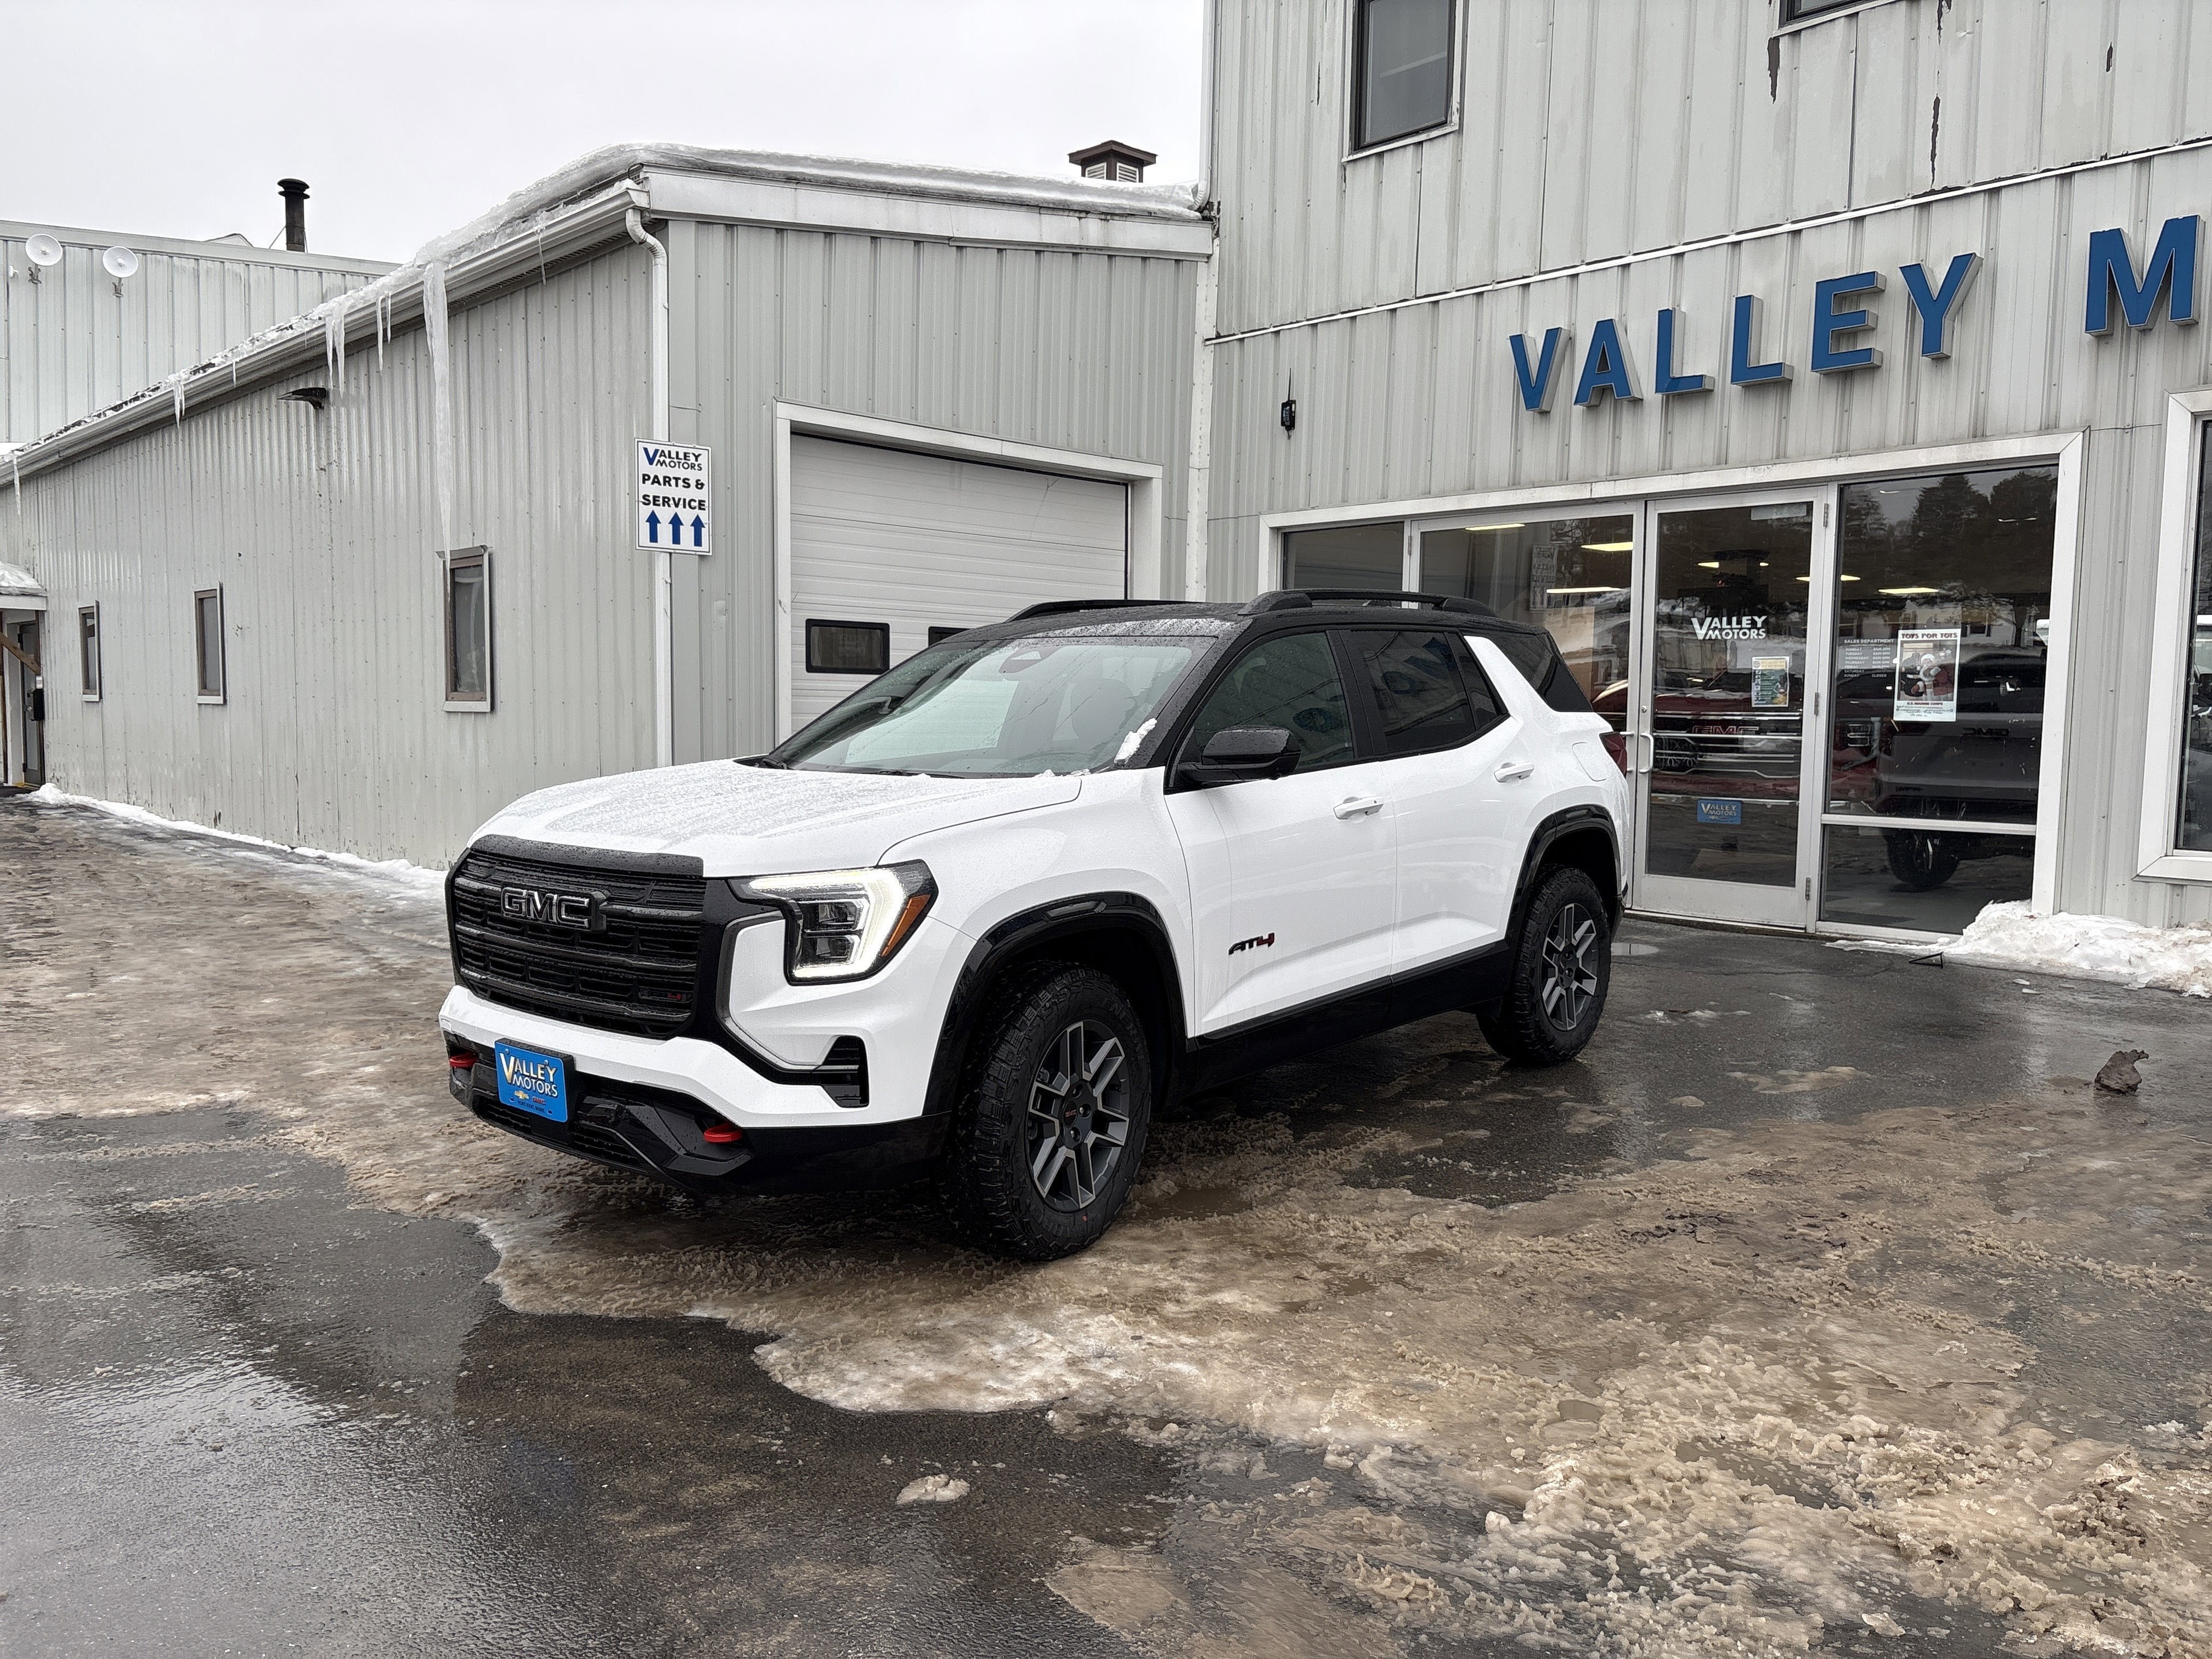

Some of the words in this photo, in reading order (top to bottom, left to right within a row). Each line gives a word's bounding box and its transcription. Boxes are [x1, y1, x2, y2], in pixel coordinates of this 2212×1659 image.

[1510, 252, 1984, 413] VALLEY
[642, 447, 702, 466] VALLEY
[655, 459, 702, 471] MOTORS
[642, 473, 691, 489] PARTS
[695, 479, 705, 490] &
[642, 494, 706, 511] SERVICE
[1691, 616, 1767, 640] VALLEY
[1705, 629, 1766, 639] MOTORS
[1701, 803, 1737, 814] VALLEY
[501, 887, 590, 929] GMC
[1228, 932, 1275, 955] AT4
[499, 1052, 557, 1084] VALLEY
[512, 1074, 558, 1097] MOTORS
